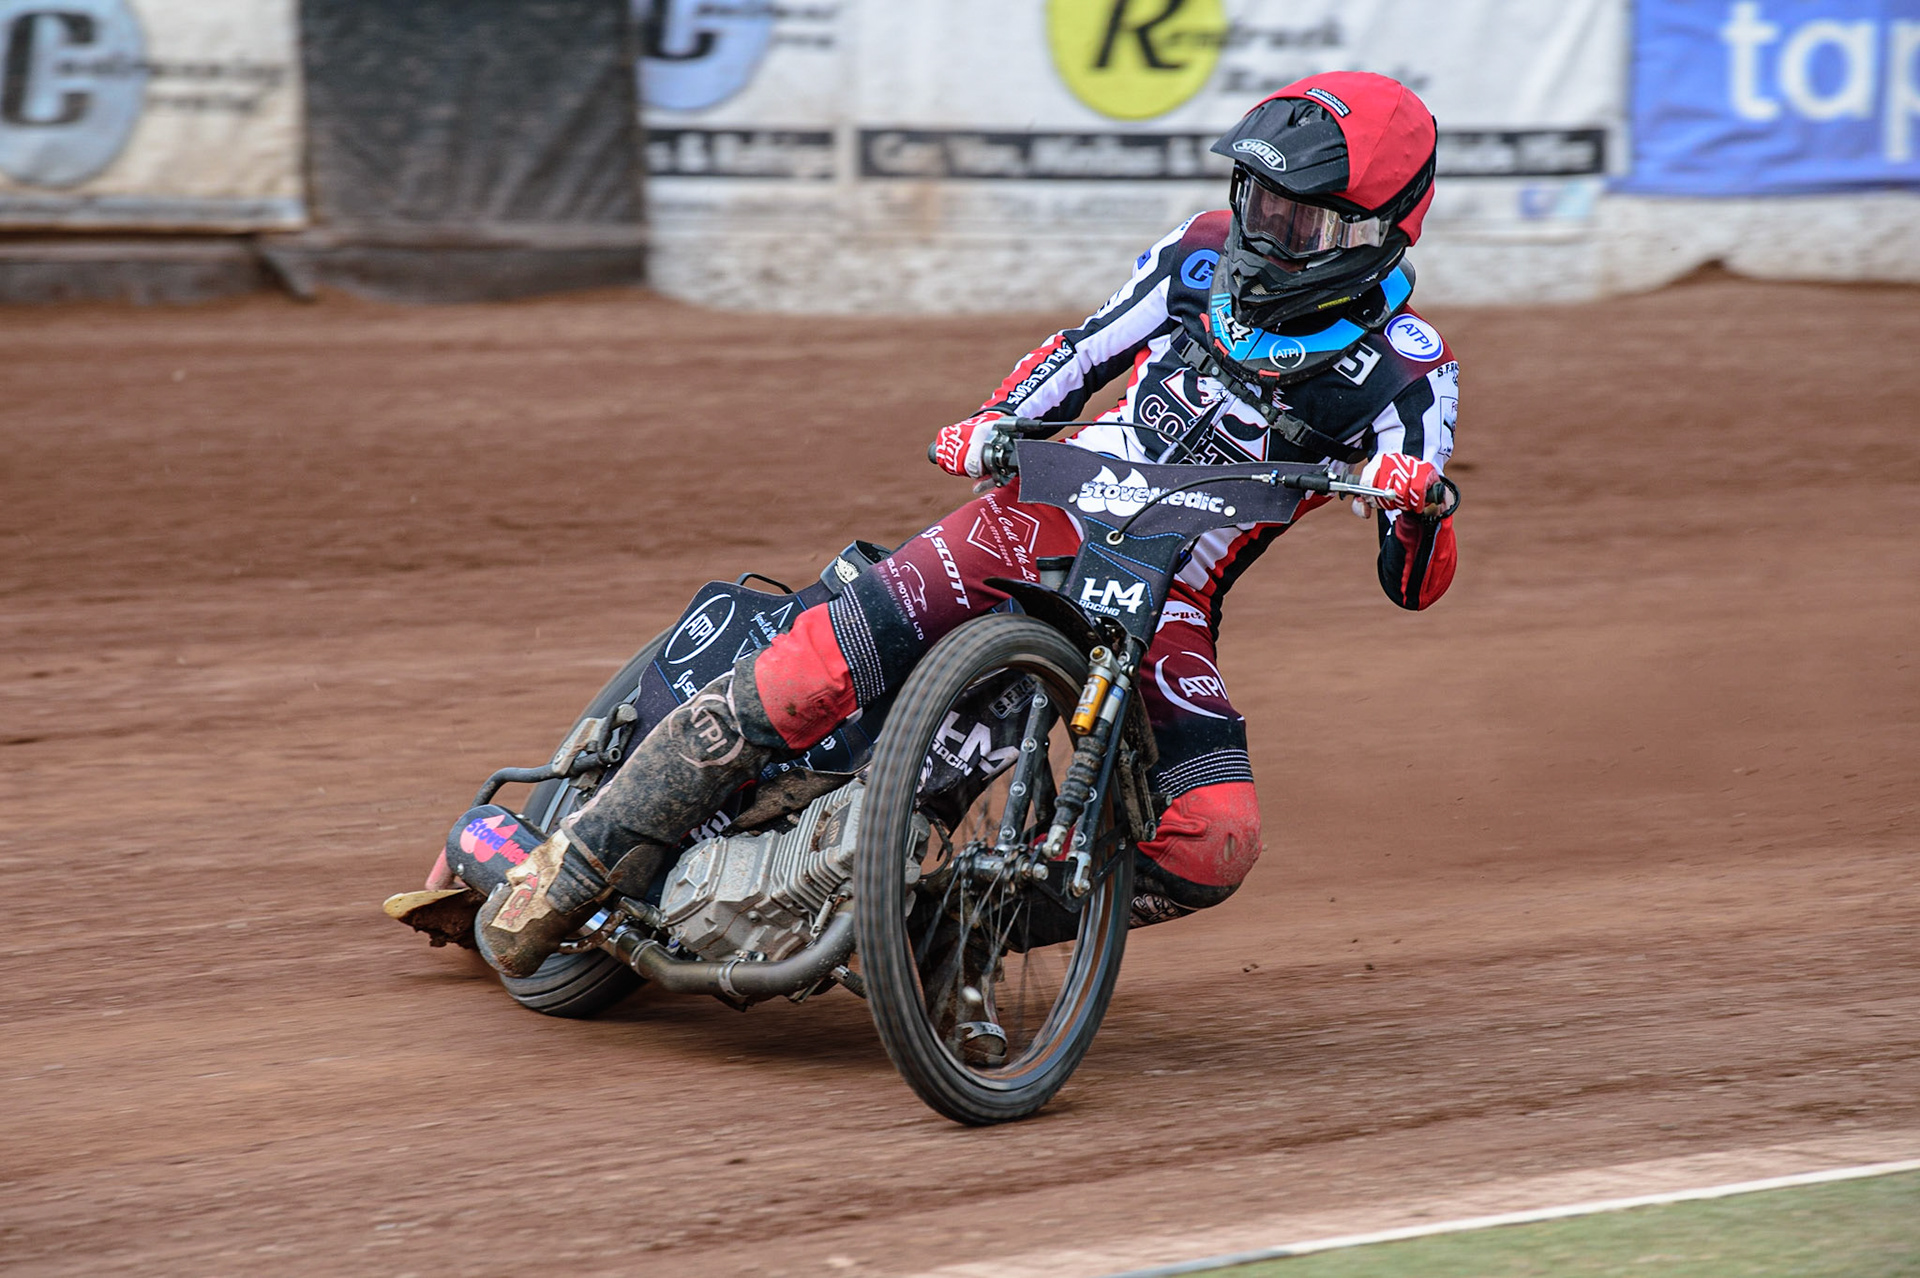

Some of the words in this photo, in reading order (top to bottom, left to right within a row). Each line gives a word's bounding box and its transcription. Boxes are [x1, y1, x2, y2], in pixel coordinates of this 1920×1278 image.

[1238, 140, 1283, 168] SHOEI
[1397, 321, 1433, 351] ATPI
[1275, 347, 1300, 359] ATPI
[931, 536, 971, 610] SCOTT
[896, 581, 917, 618] MOTORS
[912, 621, 925, 641] LTD
[1078, 599, 1121, 617] RACING
[1080, 577, 1147, 614] HM4
[685, 612, 716, 646] ATPI
[1178, 675, 1229, 701] ATPI
[931, 737, 974, 777] RACIN
